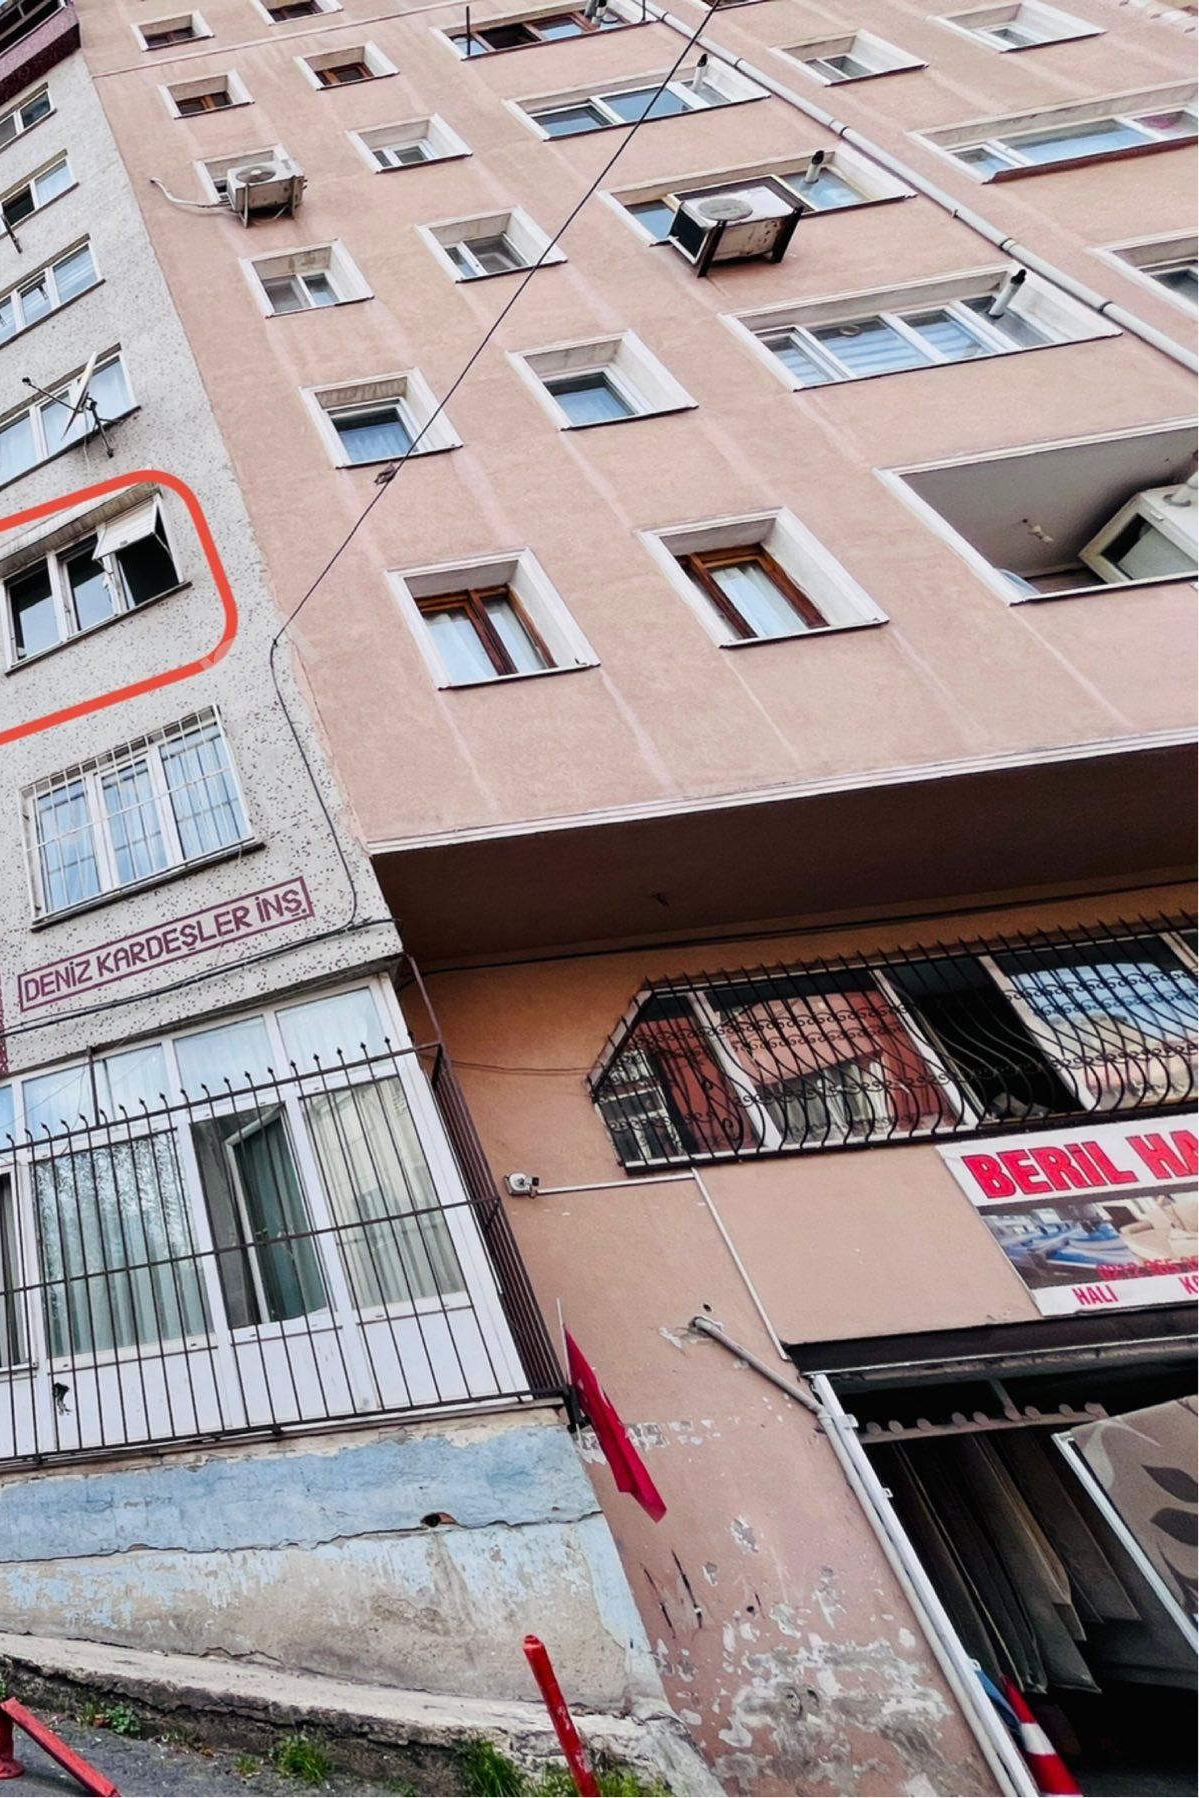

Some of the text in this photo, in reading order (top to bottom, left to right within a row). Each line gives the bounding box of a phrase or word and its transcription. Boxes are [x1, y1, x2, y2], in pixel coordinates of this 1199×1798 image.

[24, 960, 92, 1002] DENİZ
[96, 906, 253, 977] KARDEŞLER
[1072, 1284, 1120, 1306] HALI
